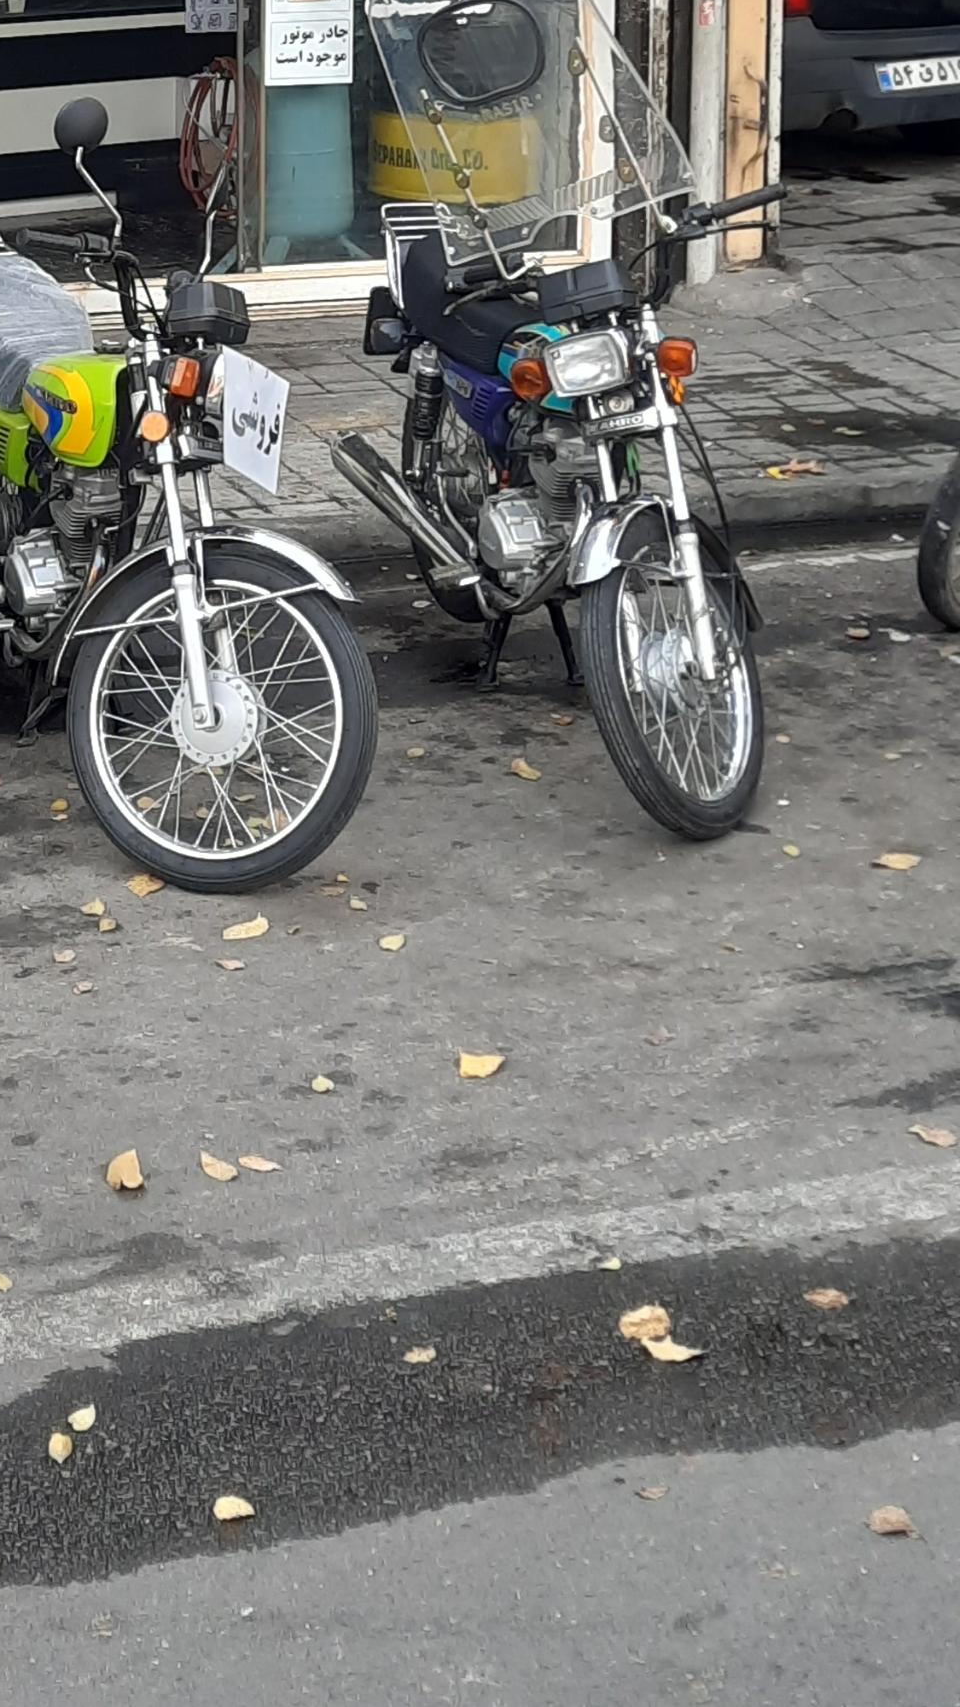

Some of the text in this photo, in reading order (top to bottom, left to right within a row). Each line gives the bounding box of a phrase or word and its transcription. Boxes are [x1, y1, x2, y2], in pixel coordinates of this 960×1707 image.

[282, 26, 314, 45] موتور
[276, 50, 347, 67] موجود است
[938, 60, 960, 81] ۵۱
[232, 392, 280, 456] فروشی
